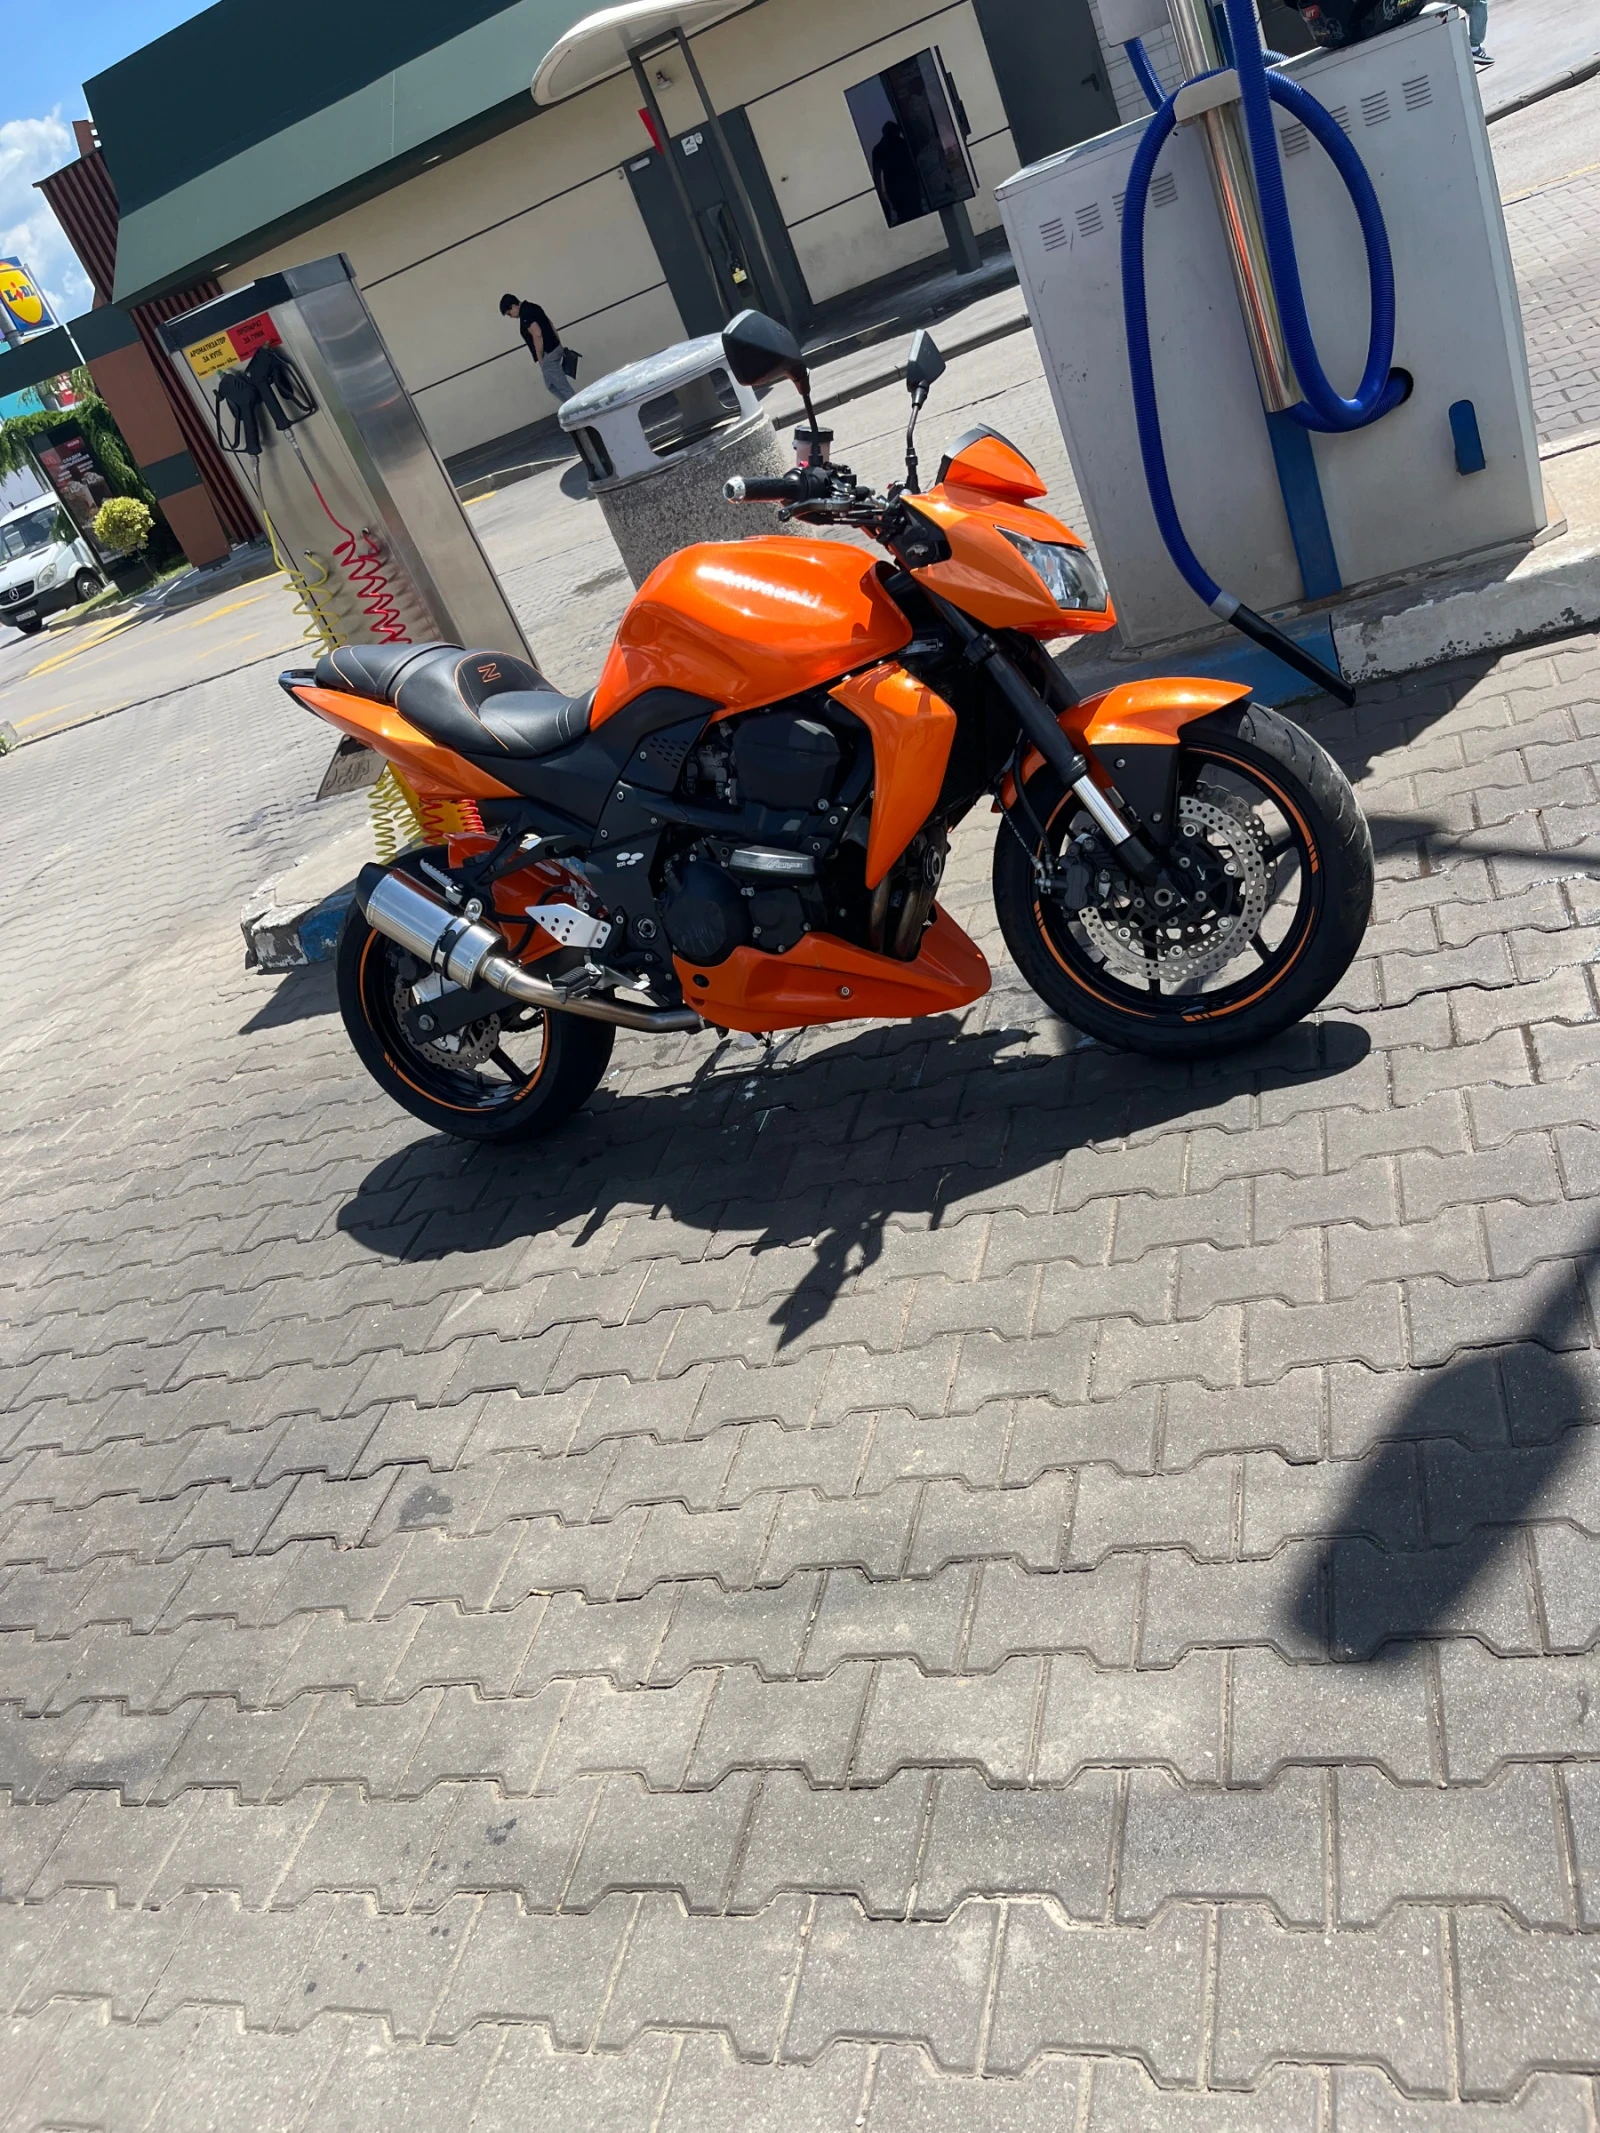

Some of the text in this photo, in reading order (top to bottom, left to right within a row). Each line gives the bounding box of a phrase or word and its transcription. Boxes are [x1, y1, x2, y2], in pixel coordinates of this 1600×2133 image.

[189, 336, 226, 358] АРОМАТИЗАТОР
[202, 349, 223, 363] ЗА КУПЕ
